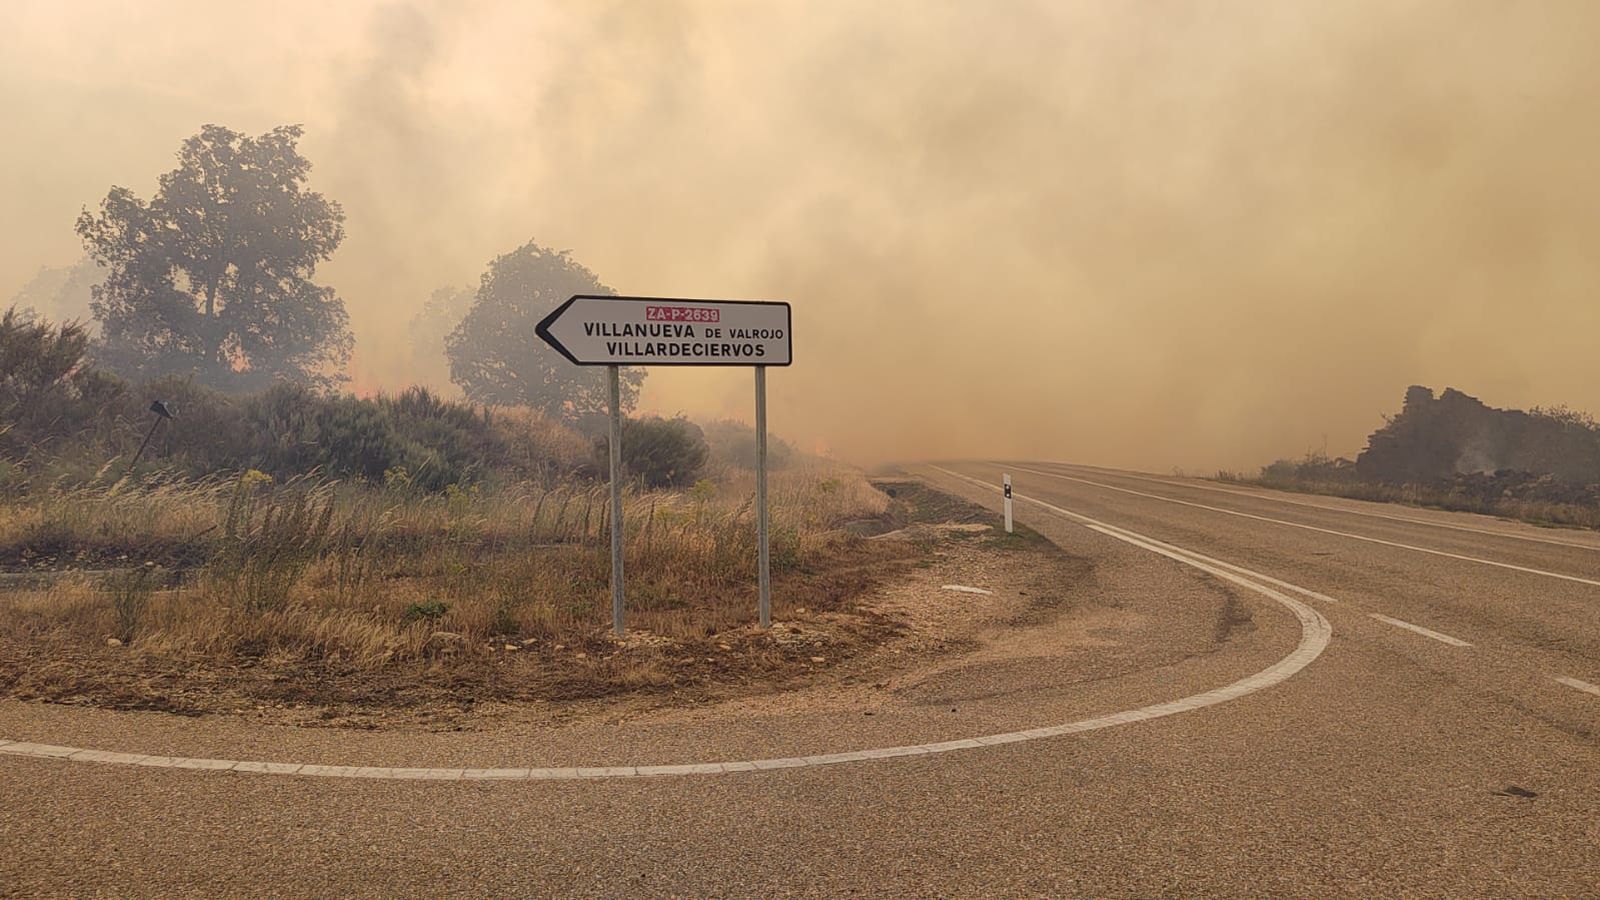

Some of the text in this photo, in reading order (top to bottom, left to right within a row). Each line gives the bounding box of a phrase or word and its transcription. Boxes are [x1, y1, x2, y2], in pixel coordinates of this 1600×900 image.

[647, 307, 718, 322] ZA-P-2639
[584, 322, 784, 340] VILLANUEVA DE VALROJO
[606, 342, 765, 357] VILLARDECIERVOS
